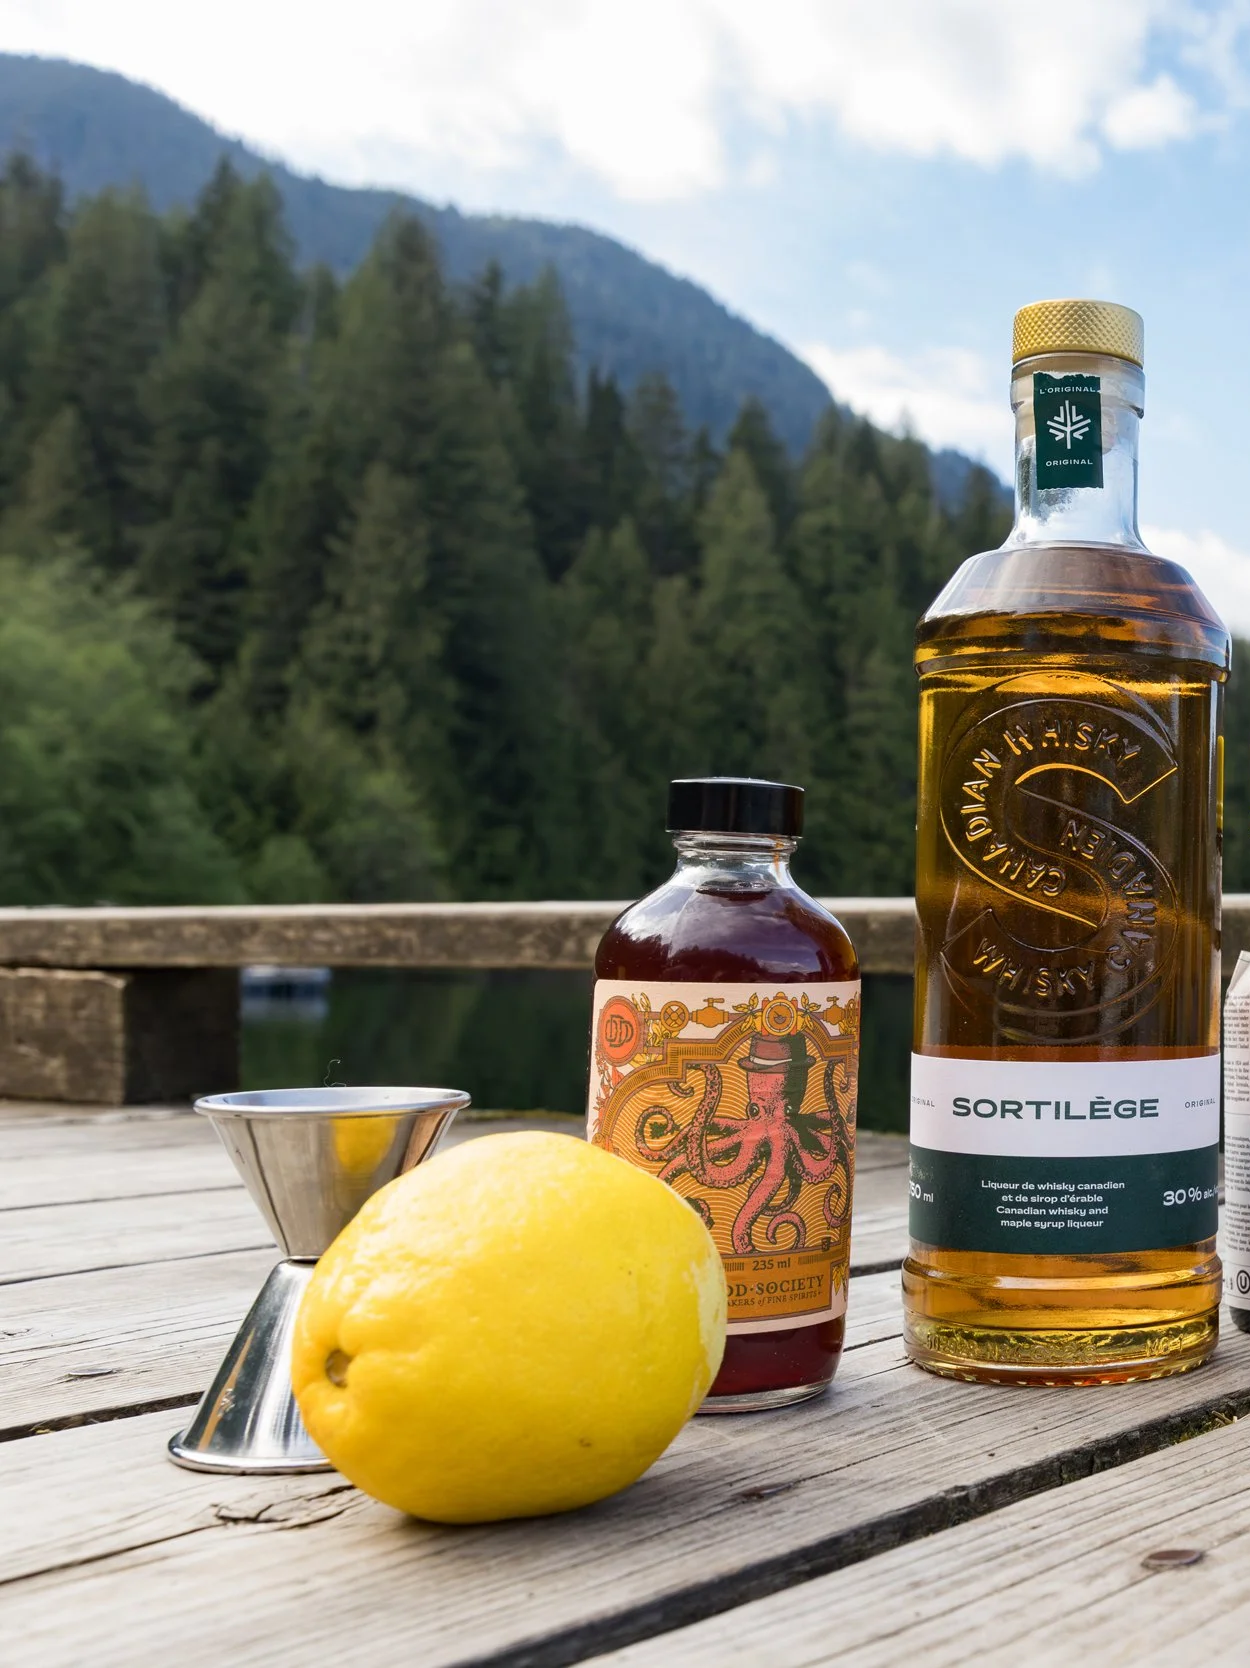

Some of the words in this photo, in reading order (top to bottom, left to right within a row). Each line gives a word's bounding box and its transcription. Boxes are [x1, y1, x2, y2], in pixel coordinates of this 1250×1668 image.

[1039, 385, 1096, 395] L'ORIGINAL
[1045, 458, 1093, 467] ORIGINAL
[1003, 719, 1141, 767] WHISKY
[961, 748, 1066, 897] CANADIAN
[973, 937, 1096, 997] WHISKY
[953, 1096, 1160, 1121] SORTILÈGE
[1184, 1098, 1216, 1109] ORIGINAL
[981, 1180, 1019, 1190] Liqueur
[1021, 1182, 1035, 1190] de
[1037, 1182, 1075, 1191] whisky
[1077, 1181, 1125, 1190] canadien
[923, 1192, 934, 1203] ml
[1001, 1194, 1013, 1202] et
[1015, 1194, 1028, 1202] de
[1030, 1194, 1058, 1204] sirop
[1060, 1194, 1103, 1203] d'érable
[996, 1205, 1046, 1215] Canadian
[1048, 1207, 1086, 1217] whisky
[1088, 1206, 1109, 1215] and
[1000, 1219, 1032, 1229] maple
[1034, 1220, 1065, 1230] syrup
[1067, 1219, 1104, 1229] liqueur
[752, 1259, 774, 1271] 235
[777, 1257, 791, 1269] ml
[756, 1274, 825, 1296] SOCIETY
[757, 1296, 766, 1306] of
[767, 1295, 787, 1304] FINE
[789, 1291, 817, 1301] SPIRITS
